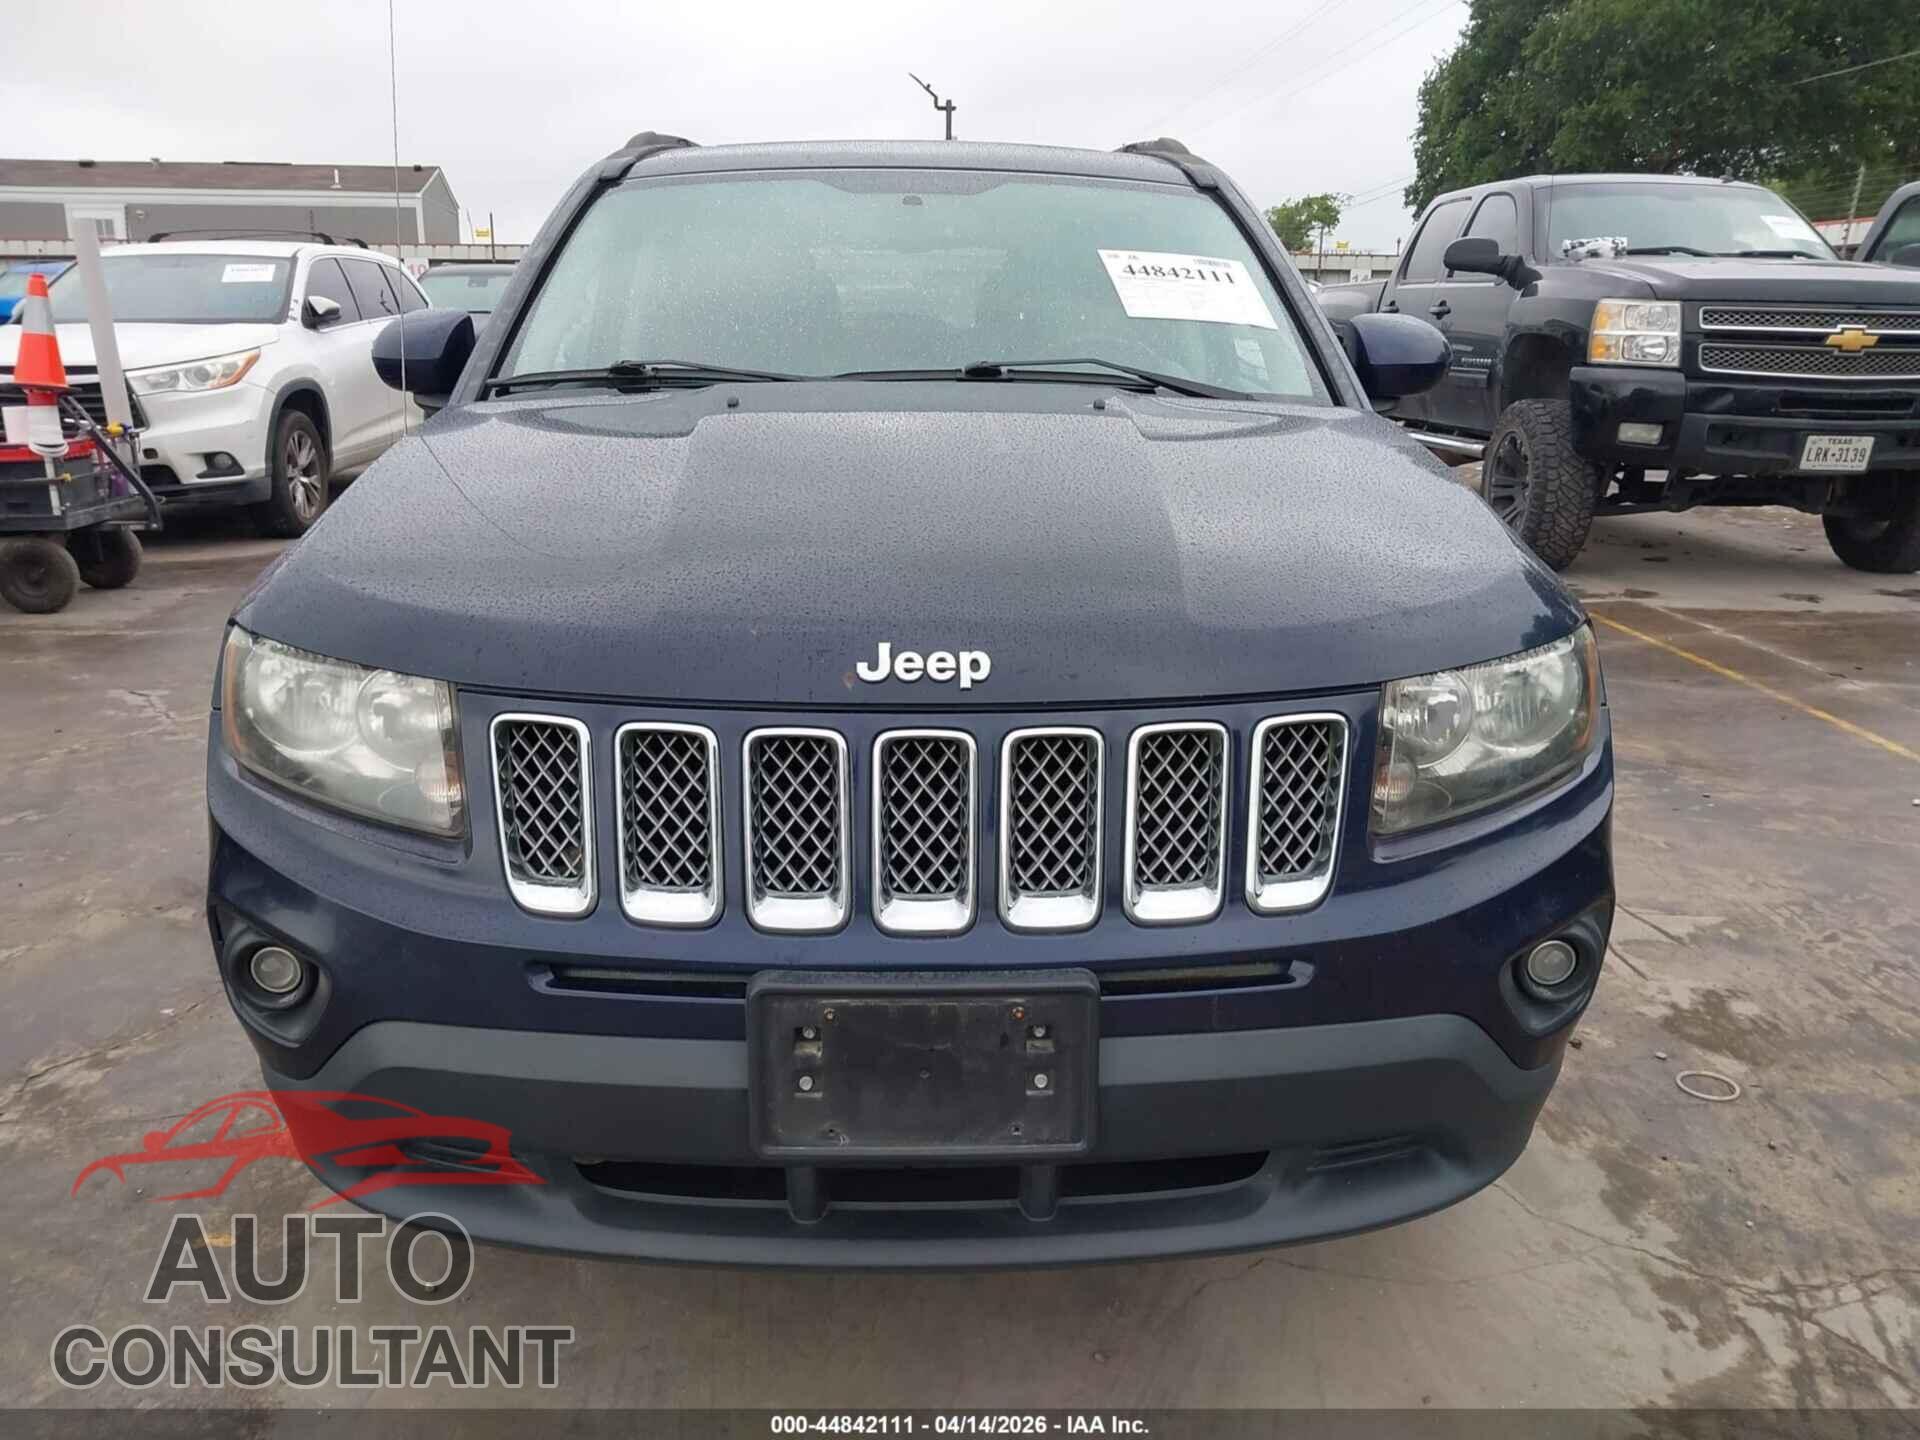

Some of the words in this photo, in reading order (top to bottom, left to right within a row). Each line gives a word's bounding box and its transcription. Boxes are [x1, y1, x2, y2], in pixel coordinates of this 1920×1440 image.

[1122, 264, 1234, 285] 44842111
[1806, 447, 1867, 463] LRK-3139
[856, 641, 992, 690] Jeep
